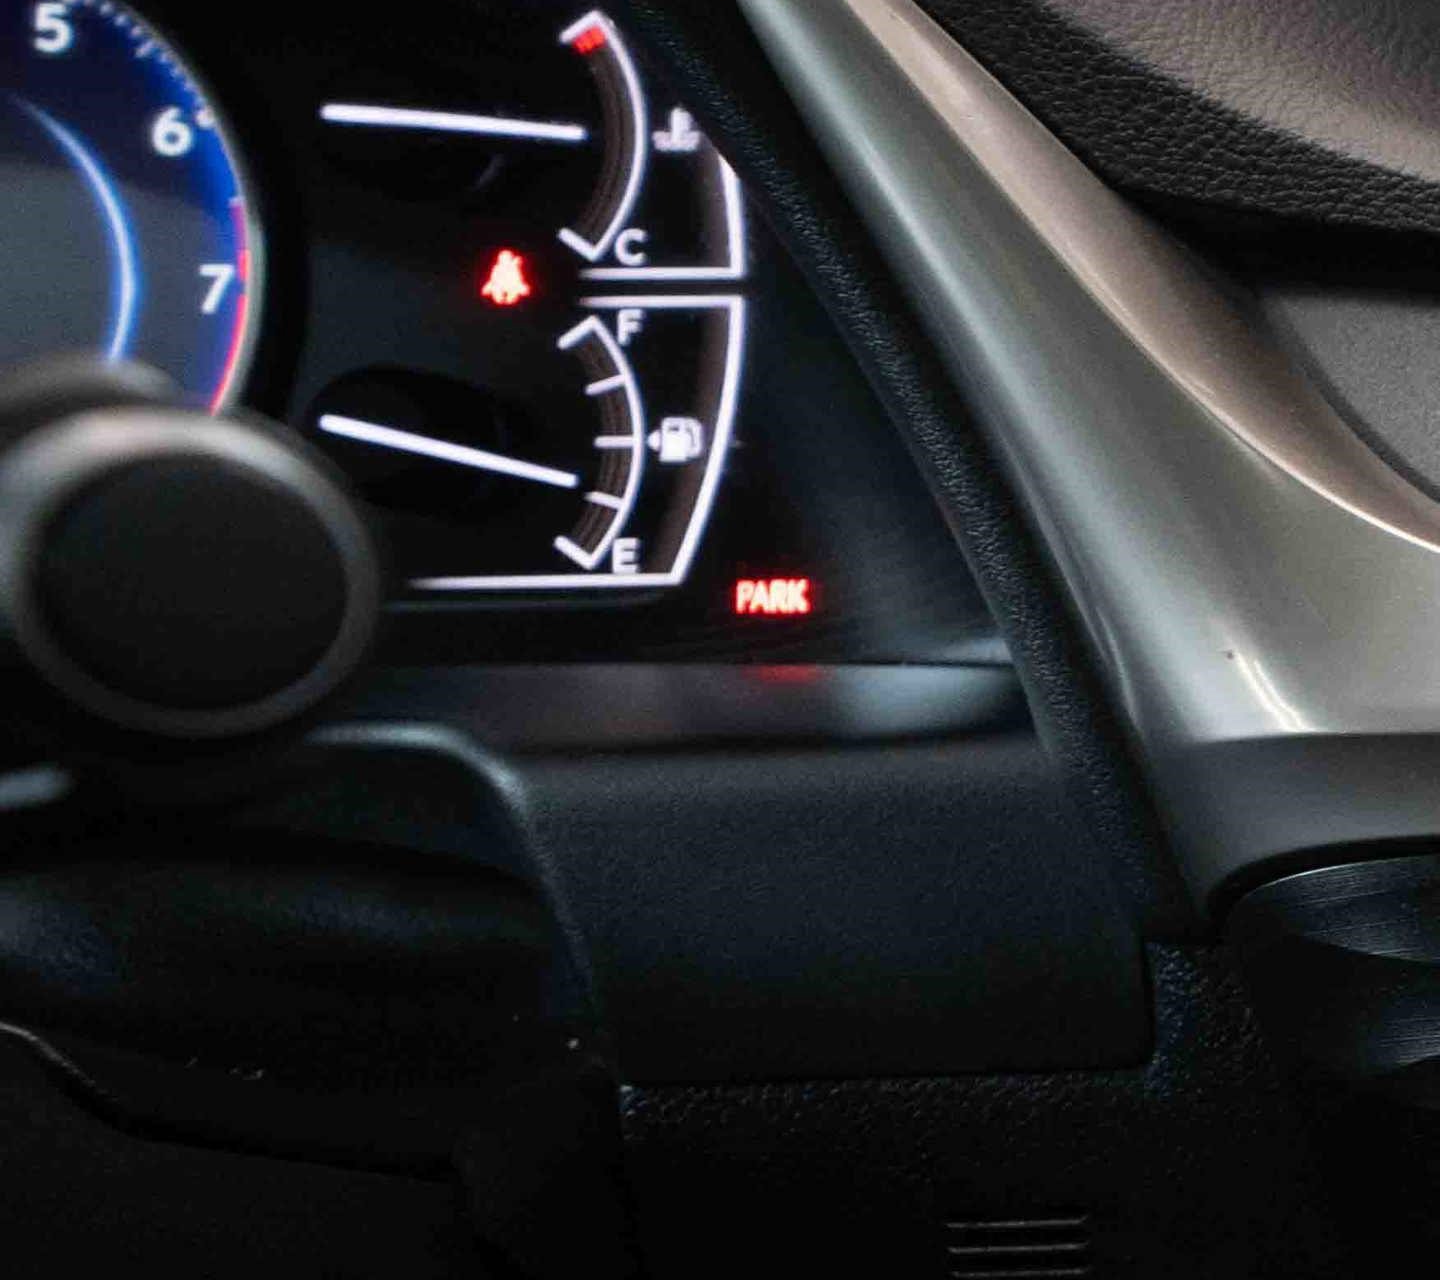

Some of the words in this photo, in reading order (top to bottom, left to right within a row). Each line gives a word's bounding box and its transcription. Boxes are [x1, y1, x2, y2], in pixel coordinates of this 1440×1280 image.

[33, 2, 74, 54] 5
[151, 113, 193, 156] 6
[614, 228, 648, 266] C
[199, 264, 237, 314] 7
[616, 310, 644, 346] F
[611, 537, 640, 575] E
[736, 579, 810, 614] PARK
